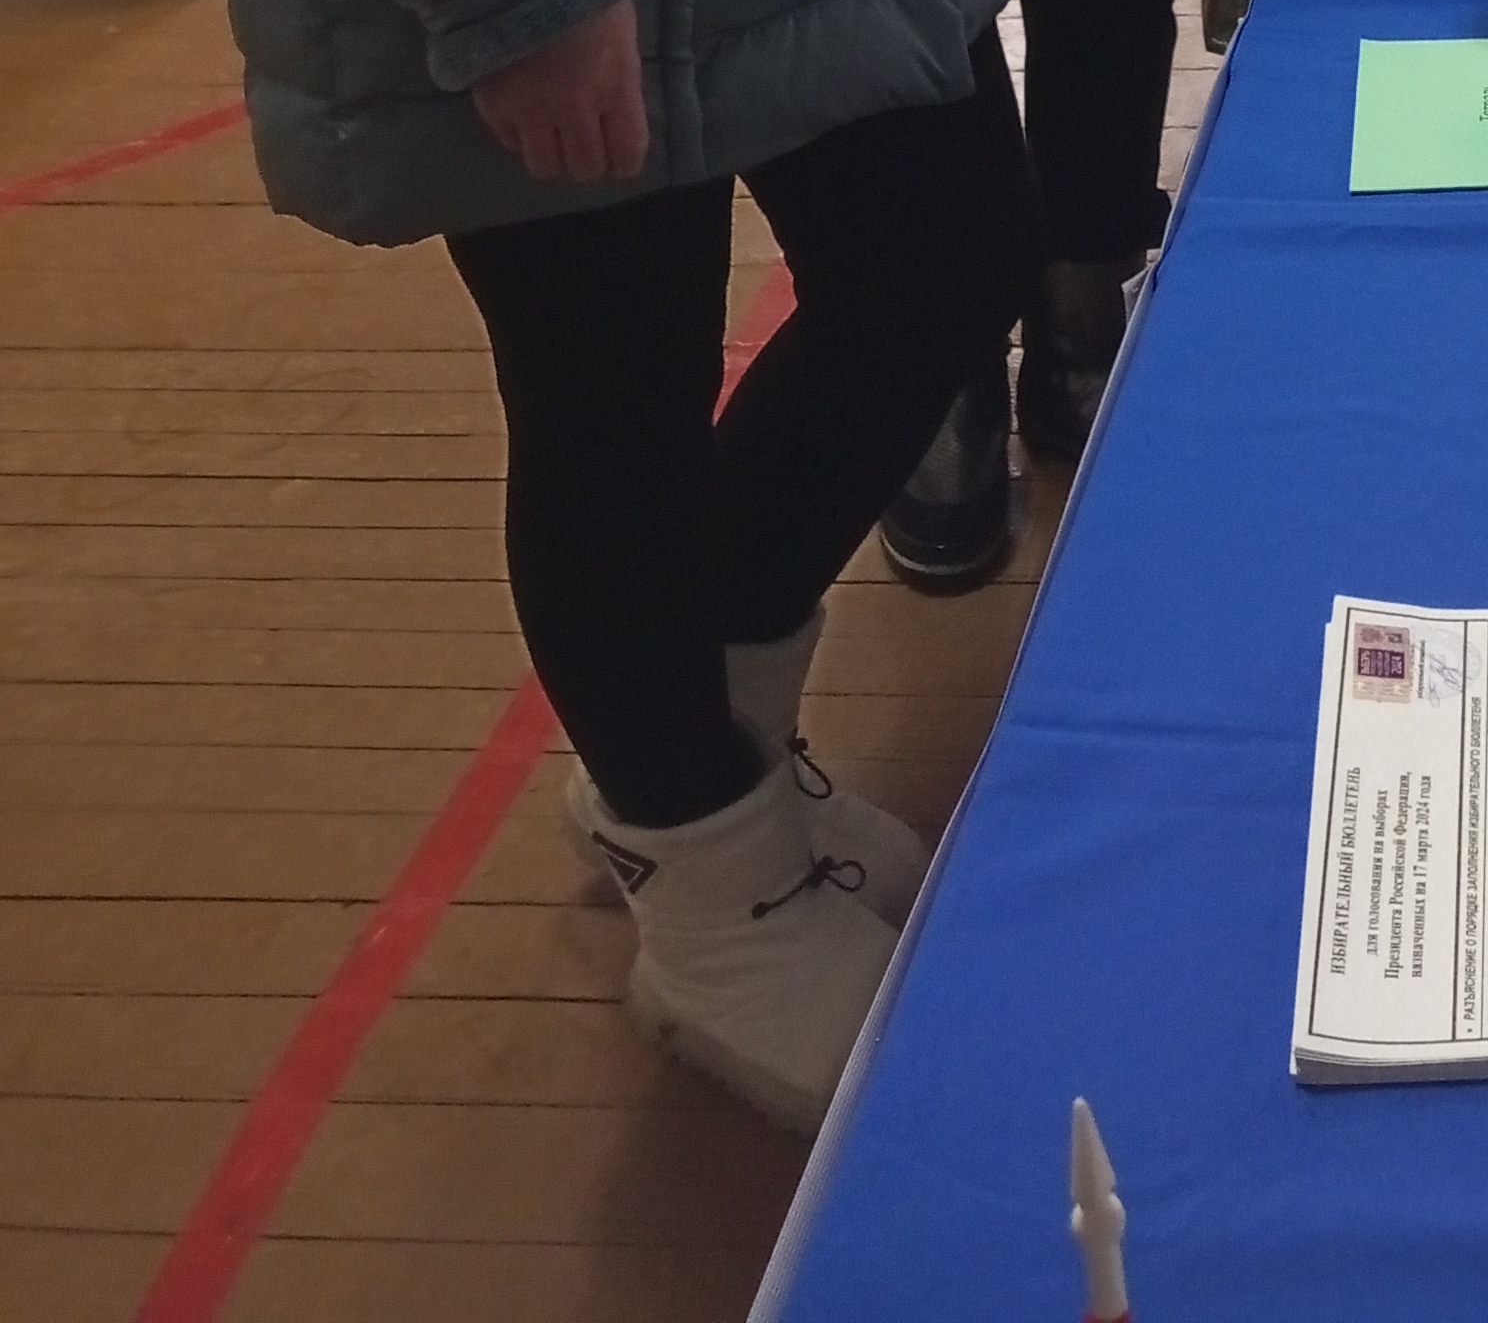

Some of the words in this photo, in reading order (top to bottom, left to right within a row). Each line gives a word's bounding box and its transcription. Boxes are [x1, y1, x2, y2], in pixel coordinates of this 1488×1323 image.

[1469, 695, 1482, 748] БЮЛЛЕТЕНЯ
[1339, 766, 1361, 849] БЮЛЛЕТЕНЬ
[1374, 788, 1388, 838] выборах
[1395, 770, 1411, 836] Федерации,
[1414, 800, 1430, 826] 2024
[1419, 774, 1431, 800] года
[1467, 748, 1481, 829] ИЗБИРАТЕЛЬНОГО
[1372, 839, 1385, 854] на
[1389, 837, 1407, 906] Российской
[1412, 863, 1427, 878] 17
[1416, 827, 1429, 863] марта
[1466, 829, 1479, 891] ЗАПОЛНЕНИЯ
[1328, 850, 1354, 975] ИЗБИРАТЕЛЬНЫЙ
[1367, 855, 1384, 931] голосования
[1414, 880, 1426, 896] на
[1464, 892, 1478, 937] ПОРЯДКЕ
[1365, 932, 1379, 956] для
[1387, 906, 1404, 979] Президента
[1410, 897, 1426, 978] назначенных
[1463, 938, 1477, 946] О
[1462, 947, 1477, 1021] РАЗЪЯСНЕНИЕ
